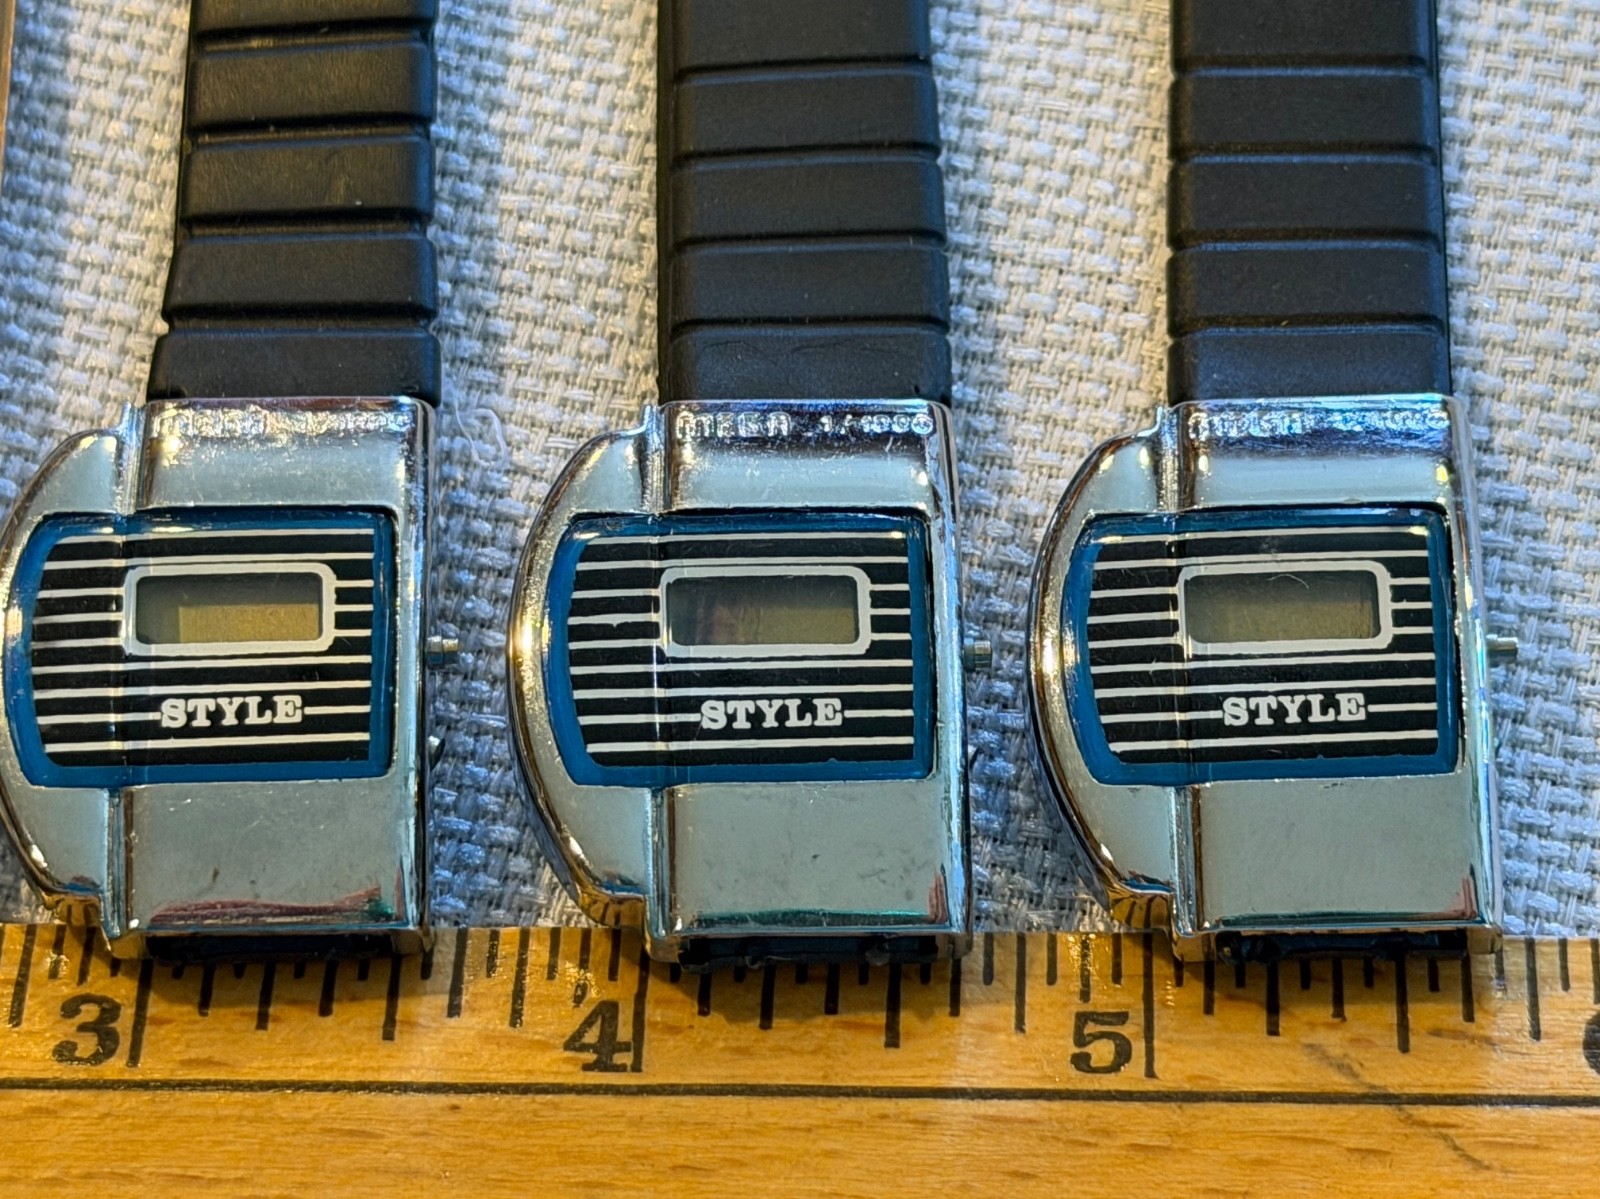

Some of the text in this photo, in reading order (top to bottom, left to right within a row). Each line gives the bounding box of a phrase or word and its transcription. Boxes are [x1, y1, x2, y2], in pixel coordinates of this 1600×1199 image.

[161, 695, 304, 729] STYLE
[700, 697, 843, 730] STYLE
[1222, 692, 1368, 727] STYLE
[51, 993, 121, 1067] 3
[563, 1000, 632, 1072] 4
[1070, 1010, 1132, 1074] 5
